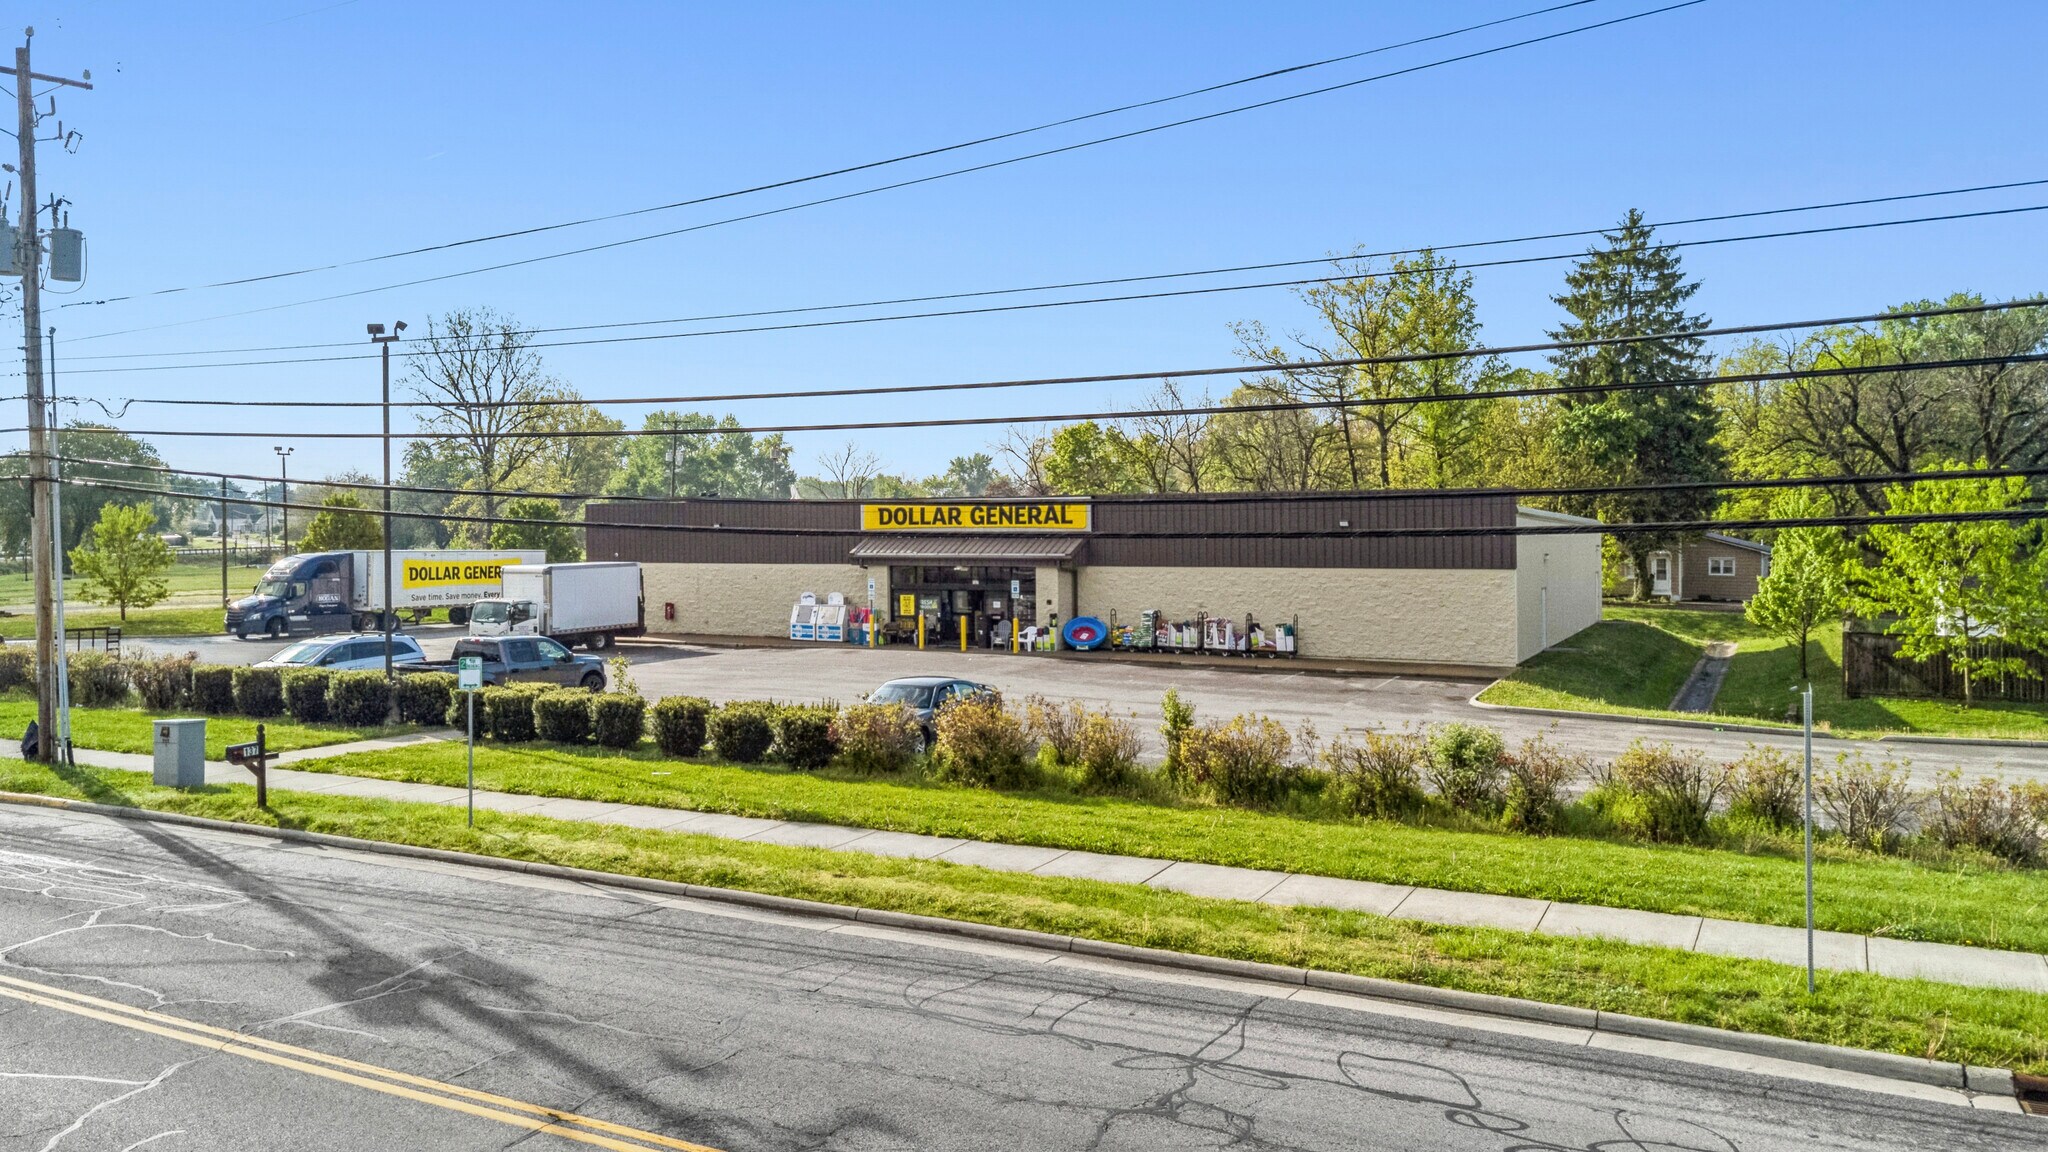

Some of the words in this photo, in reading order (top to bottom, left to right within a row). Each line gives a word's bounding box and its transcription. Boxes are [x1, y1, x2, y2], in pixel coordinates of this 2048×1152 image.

[878, 507, 962, 525] DOLLAR
[970, 505, 1073, 525] GENERAL
[409, 566, 460, 581] DOLLAR
[464, 565, 502, 580] GENER
[445, 592, 459, 600] Save
[461, 592, 482, 600] money.
[484, 591, 500, 599] Every
[461, 660, 466, 668] 2
